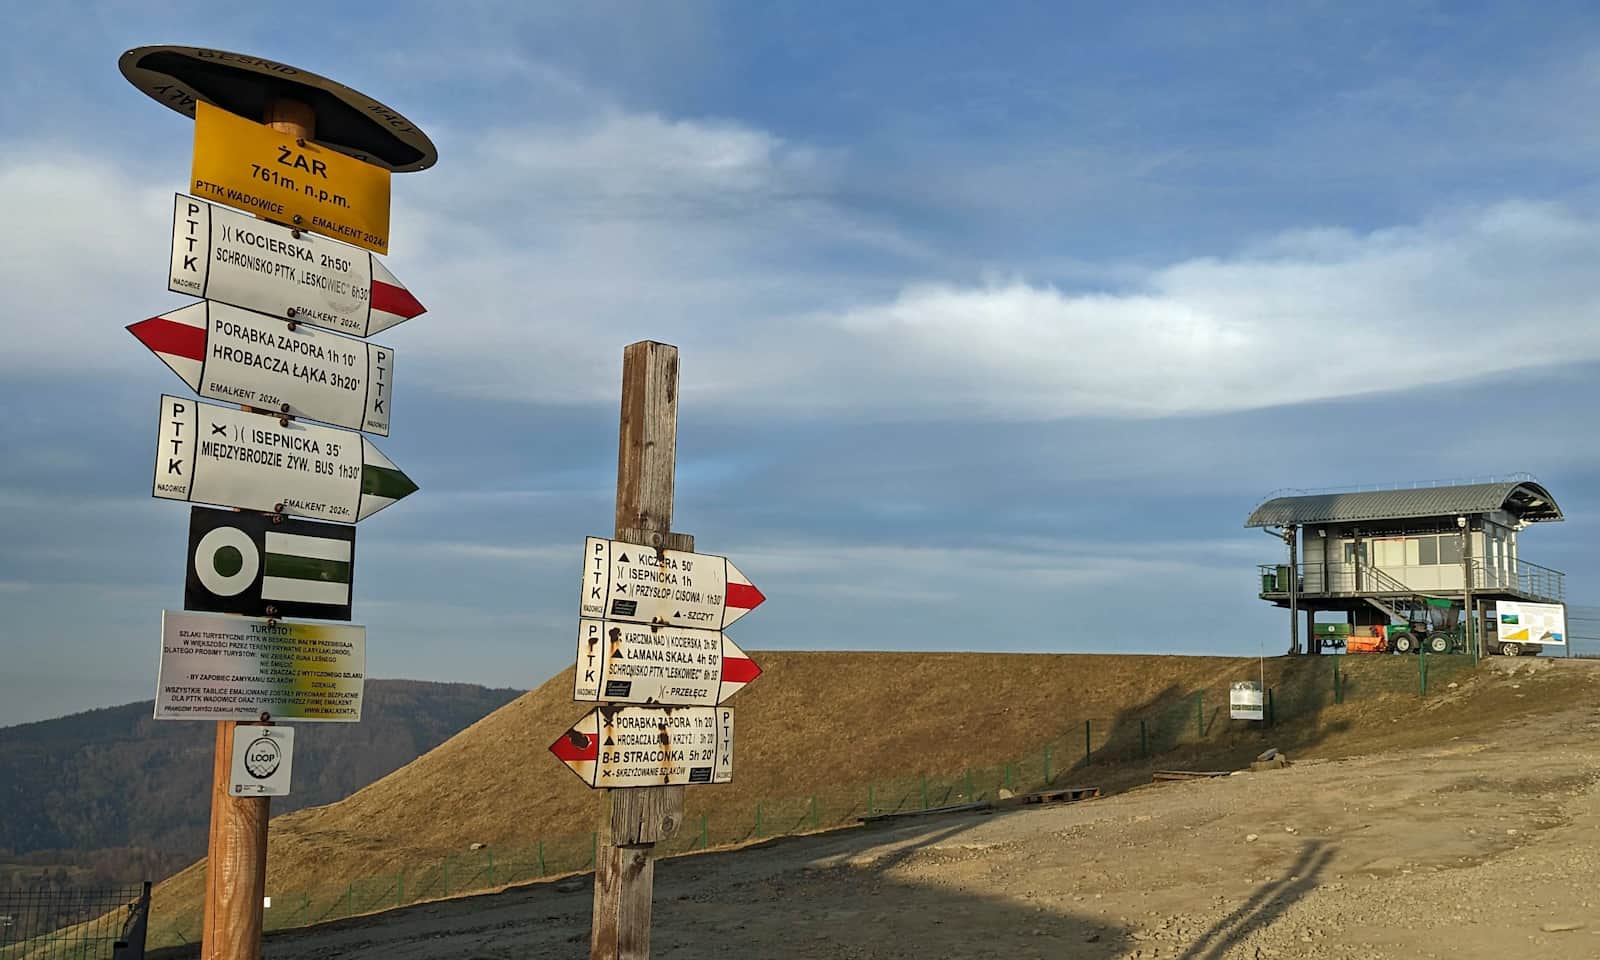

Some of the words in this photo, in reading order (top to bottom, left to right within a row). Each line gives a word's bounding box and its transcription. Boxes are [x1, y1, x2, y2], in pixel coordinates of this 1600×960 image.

[277, 145, 328, 179] ŻAR
[251, 163, 300, 192] 761m.
[304, 184, 351, 209] n.p.m.
[196, 179, 224, 197] PTTK
[227, 188, 285, 215] WADOWICE
[312, 216, 363, 240] EMALKENT
[183, 203, 200, 272] PTTK
[235, 227, 314, 263] KOCIERSKA
[320, 254, 352, 274] 2h50'
[216, 247, 273, 274] SCHRONISKO
[274, 261, 295, 281] PTTK
[173, 278, 200, 290] WADOWICE
[296, 306, 338, 323] EMALKENT
[340, 318, 361, 330] 2024r.
[215, 319, 275, 347] PORĄBKA
[277, 335, 325, 361] ZAPORA
[327, 345, 340, 364] 1h
[342, 349, 357, 368] 10'
[213, 343, 290, 375] HROBACZA
[292, 360, 328, 385] ŁĄKA
[330, 371, 361, 392] 3h20'
[374, 351, 387, 414] PTTK
[210, 382, 256, 400] EMALKENT
[259, 392, 281, 407] 2024r.
[168, 402, 185, 476] PTTK
[252, 428, 320, 454] ISEPNICKA
[326, 442, 342, 458] 35'
[201, 439, 283, 468] MIĘDZYBRODZIE
[287, 451, 311, 473] ŻYW.
[315, 459, 335, 477] BUS
[157, 482, 187, 495] WADOWICE
[283, 497, 326, 513] EMALKENT
[329, 504, 351, 518] 2024r.
[591, 543, 604, 600] PTTK
[638, 554, 678, 570] KICZERA
[681, 560, 694, 573] 50'
[629, 568, 678, 586] ISEPNICKA
[681, 577, 692, 588] 1h
[636, 584, 671, 599] PRZYSŁOP
[687, 611, 715, 622] SZCZYT
[179, 630, 201, 639] SZLAKI
[625, 632, 652, 645] KARCZMA
[671, 636, 702, 650] KOCIERSKA
[164, 646, 194, 655] DLATEGO
[195, 648, 222, 656] PROSIMY
[627, 648, 664, 662] ŁAMANA
[665, 650, 694, 664] SKAŁA
[697, 653, 706, 665] 4h
[708, 654, 719, 667] 50'
[609, 663, 648, 678] SCHRONISKO
[649, 665, 664, 678] PTTK
[670, 687, 708, 699] PRZEŁĘCZ
[617, 716, 657, 731] PORĄBKA
[617, 733, 652, 746] HROBACZA
[722, 711, 730, 766] PTTK
[251, 753, 275, 763] LOOP
[602, 750, 621, 764] B-B
[623, 749, 684, 763] STRACONKA
[689, 749, 700, 761] 5h
[701, 748, 714, 761] 20'
[616, 767, 659, 778] SKRZYŻOWANIE
[658, 766, 686, 776] SZLAKÓW
